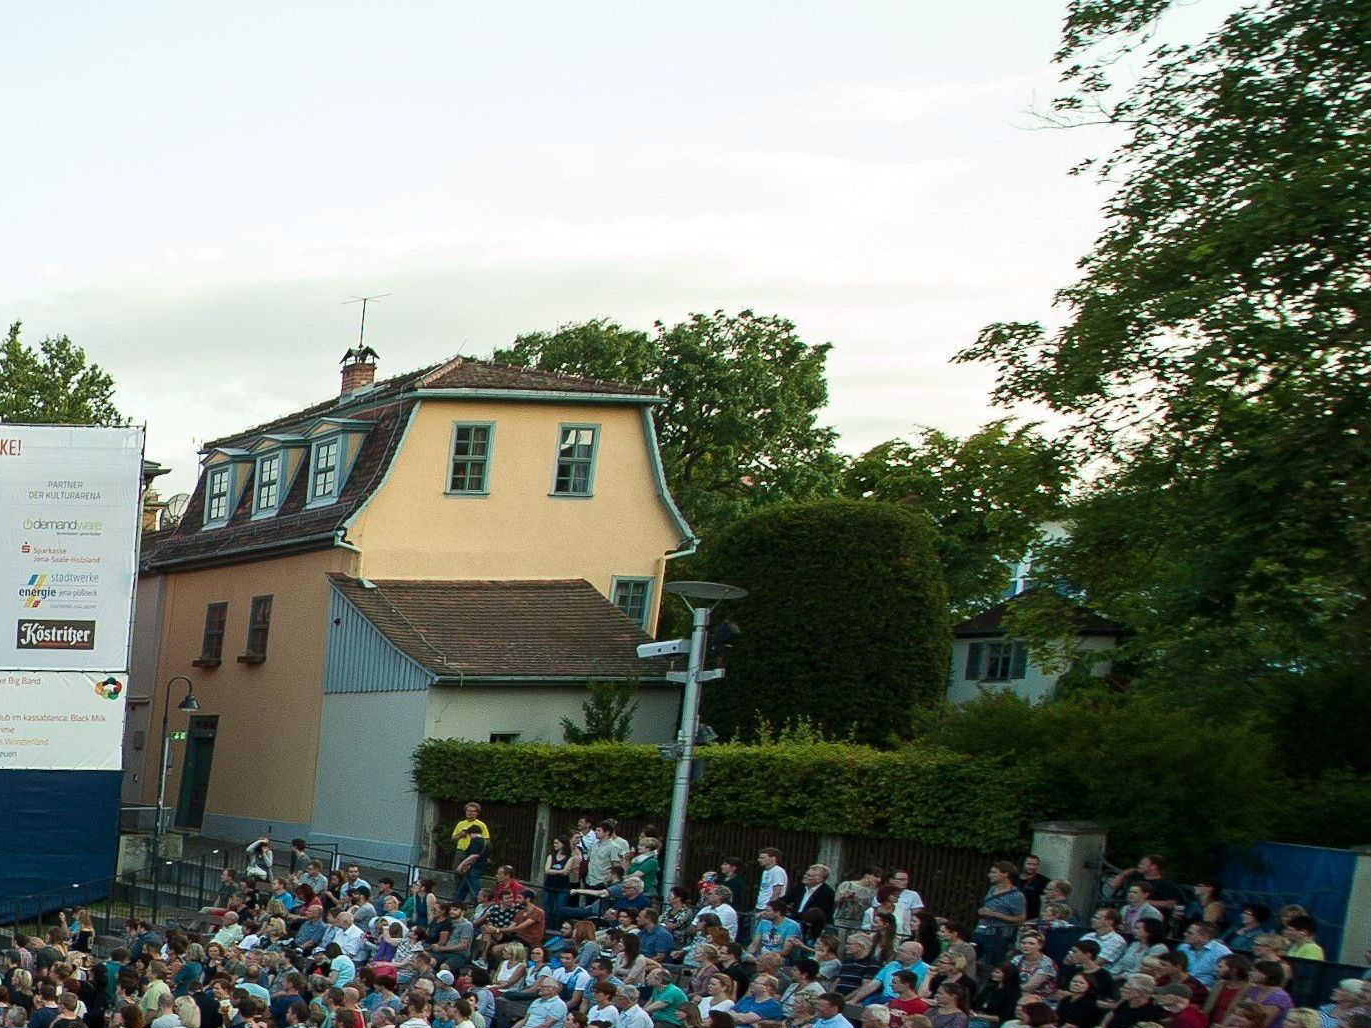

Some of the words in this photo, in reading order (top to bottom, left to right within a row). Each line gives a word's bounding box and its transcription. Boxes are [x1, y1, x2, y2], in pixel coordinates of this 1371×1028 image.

[47, 480, 84, 490] PARTNER
[28, 491, 44, 500] DER
[45, 491, 101, 501] KULTURARENA
[33, 547, 67, 555] Sparkasse
[51, 572, 99, 583] stadtwerke
[18, 586, 57, 600] energie
[20, 622, 90, 645] Köstritzer
